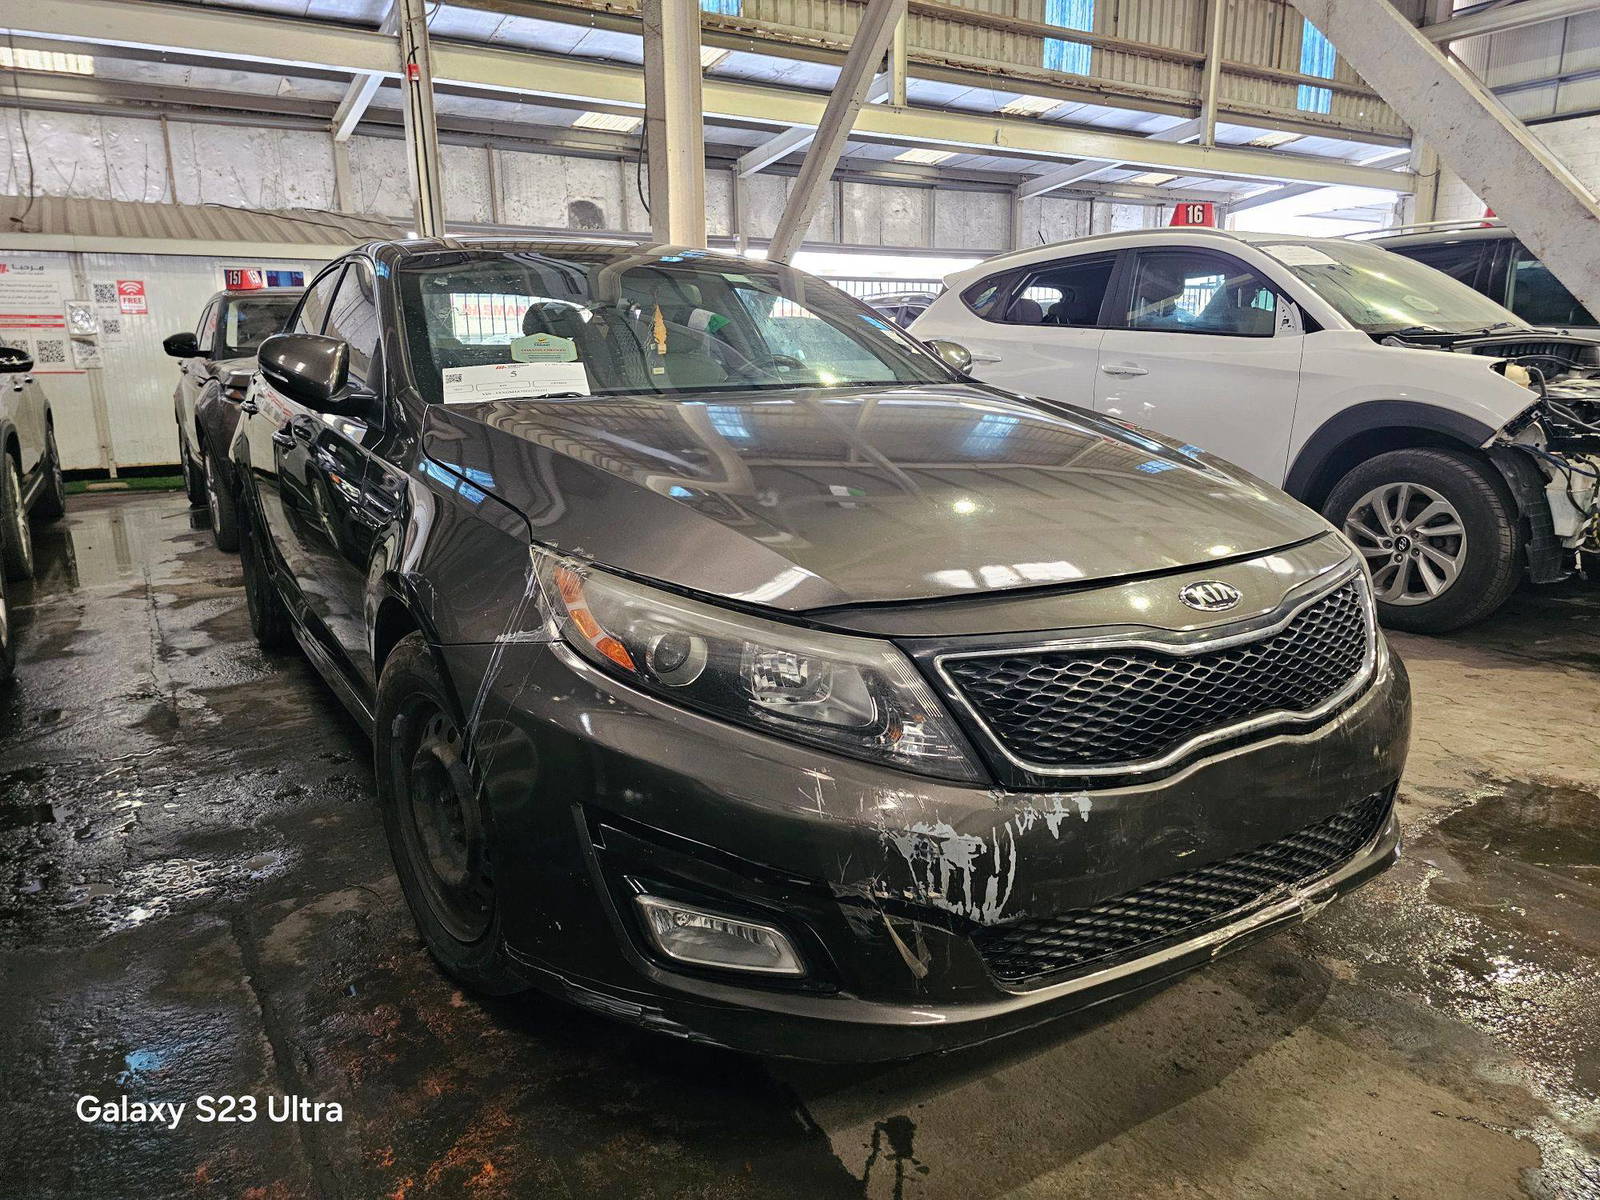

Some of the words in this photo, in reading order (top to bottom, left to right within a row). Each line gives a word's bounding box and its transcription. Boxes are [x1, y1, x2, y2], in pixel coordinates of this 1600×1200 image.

[1187, 204, 1203, 224] 16
[230, 270, 241, 284] 151
[123, 296, 143, 304] FREE
[1184, 583, 1237, 607] KIA
